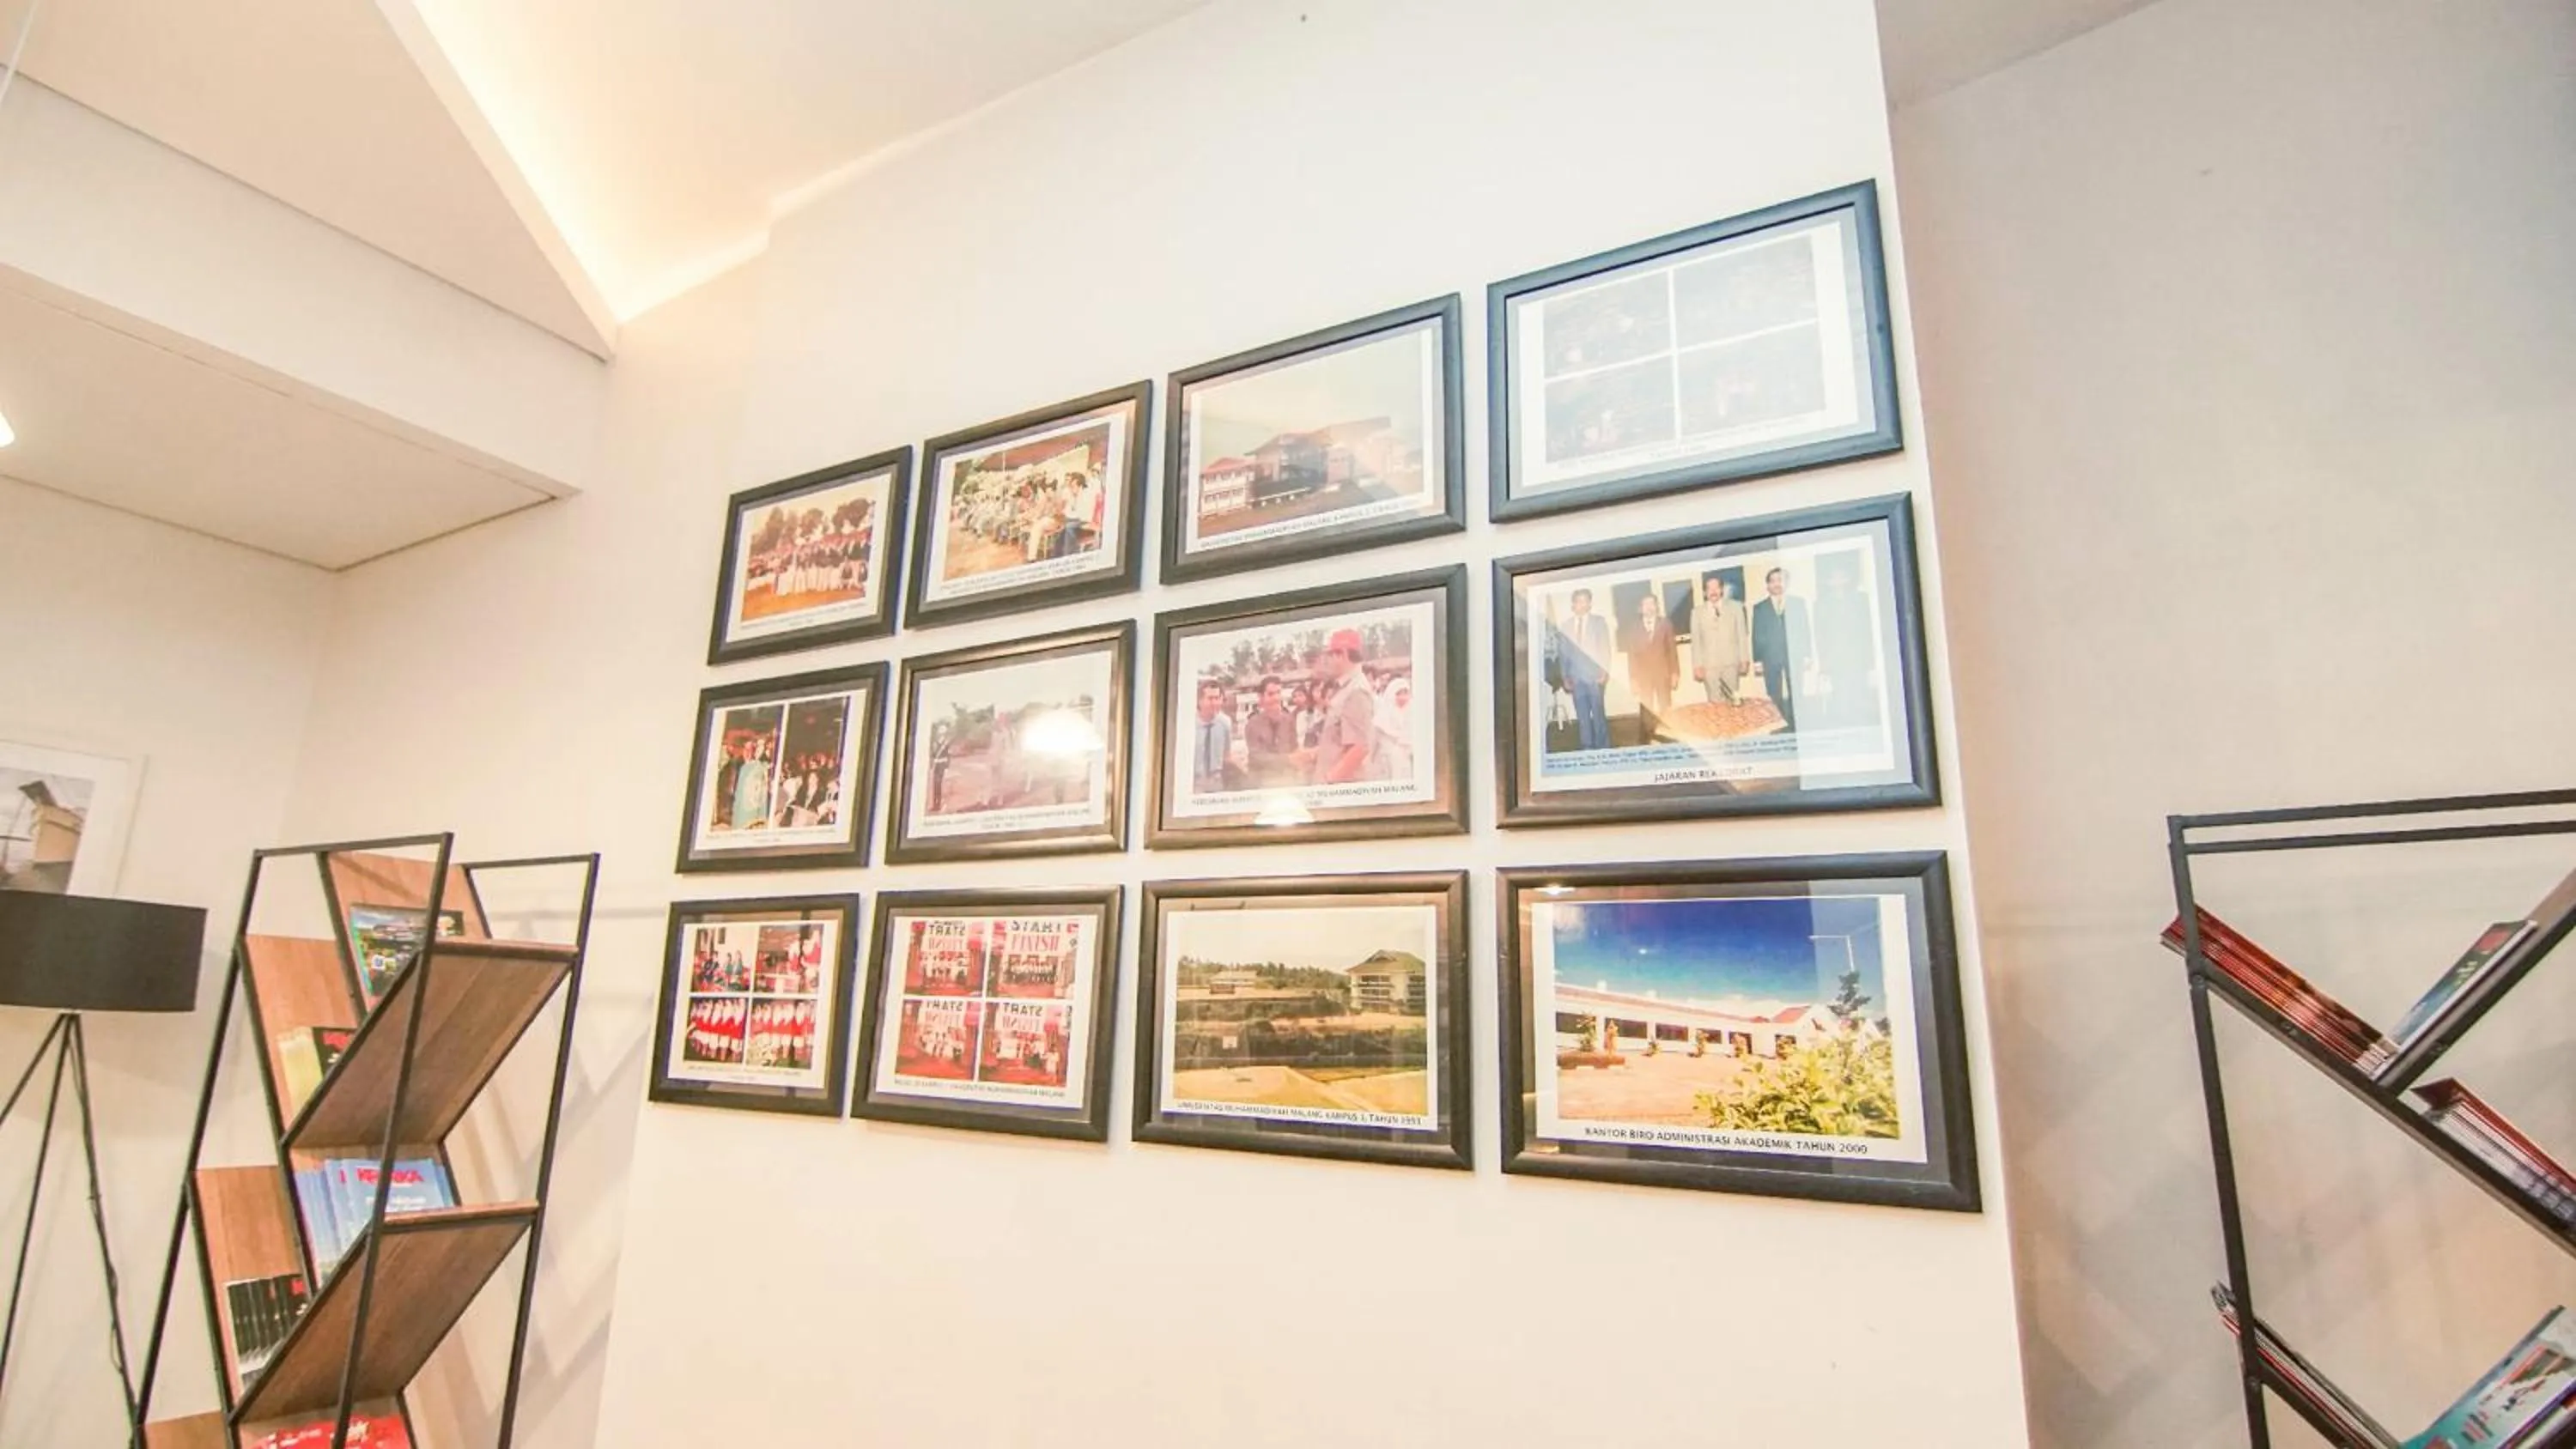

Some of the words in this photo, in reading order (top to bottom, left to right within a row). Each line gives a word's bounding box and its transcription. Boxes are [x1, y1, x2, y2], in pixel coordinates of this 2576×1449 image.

[1655, 771, 1696, 782] JAJARAN
[1584, 1127, 1627, 1138] KANTOR
[1629, 1129, 1655, 1141] BIRO
[1656, 1131, 1730, 1146] ADMINISTRASI
[1734, 1136, 1792, 1149] AKADEMIK
[1795, 1140, 1835, 1152] TAHUN
[1839, 1143, 1868, 1155] 2000
